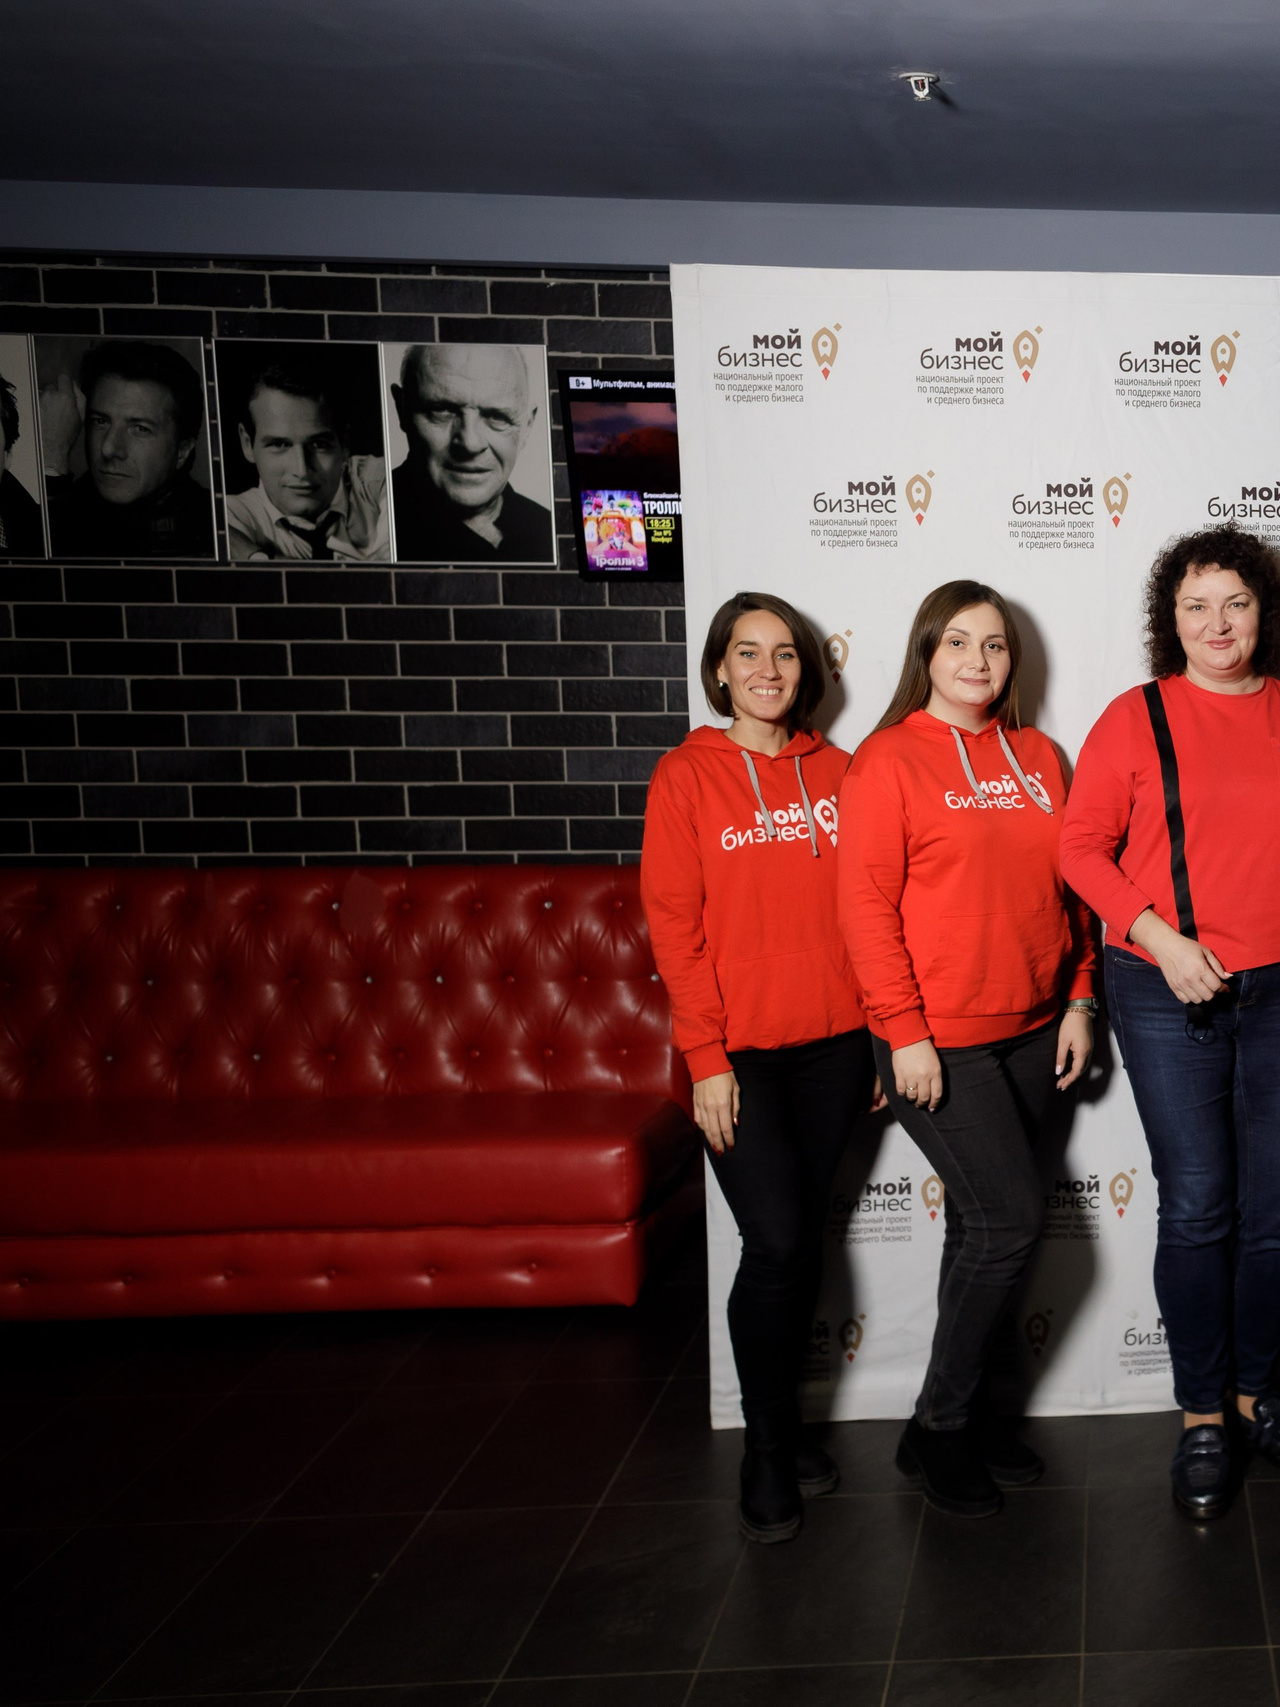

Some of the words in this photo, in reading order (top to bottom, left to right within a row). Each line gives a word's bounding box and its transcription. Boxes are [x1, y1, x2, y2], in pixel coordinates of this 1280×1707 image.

[752, 328, 802, 349] мой
[954, 331, 1004, 352] мой
[1153, 335, 1202, 355] мой
[717, 345, 803, 368] бизнес
[920, 348, 1004, 370] бизнес
[1119, 351, 1202, 374] бизнес
[713, 372, 773, 382] национальный
[775, 373, 803, 383] проект
[915, 374, 975, 385] национальный
[977, 375, 1004, 386] проект
[1114, 377, 1172, 388] национальный
[1174, 379, 1202, 389] проект
[715, 383, 725, 391] по
[727, 383, 773, 393] поддержке
[917, 385, 927, 393] по
[929, 386, 974, 395] поддержке
[976, 386, 1004, 394] малого
[1115, 388, 1126, 396] по
[1127, 389, 1172, 398] поддержке
[1173, 389, 1201, 397] малого
[732, 394, 770, 403] среднего
[771, 393, 804, 402] бизнеса
[934, 396, 971, 405] среднего
[972, 395, 1004, 405] бизнеса
[1131, 399, 1168, 408] среднего
[1169, 398, 1201, 408] бизнеса
[847, 475, 896, 496] мой
[1045, 477, 1094, 498] мой
[813, 492, 897, 514] бизнес
[1012, 494, 1094, 515] бизнес
[649, 519, 671, 528] 18:25
[809, 518, 868, 528] национальный
[870, 519, 898, 528] проект
[1008, 519, 1066, 530] национальный
[1067, 520, 1095, 530] проект
[823, 529, 868, 538] поддержке
[869, 529, 898, 537] малого
[1009, 530, 1020, 538] по
[1021, 530, 1065, 540] поддержке
[828, 539, 865, 548] среднего
[866, 538, 898, 547] бизнеса
[1026, 540, 1062, 550] среднего
[1063, 539, 1095, 549] бизнеса
[637, 555, 645, 567] 3
[944, 790, 1026, 810] бизнес
[866, 1177, 912, 1196] мой
[1055, 1175, 1100, 1193] мой
[832, 1194, 912, 1214] бизнес
[1044, 1195, 1100, 1209] знес
[1124, 1327, 1168, 1346] биз
